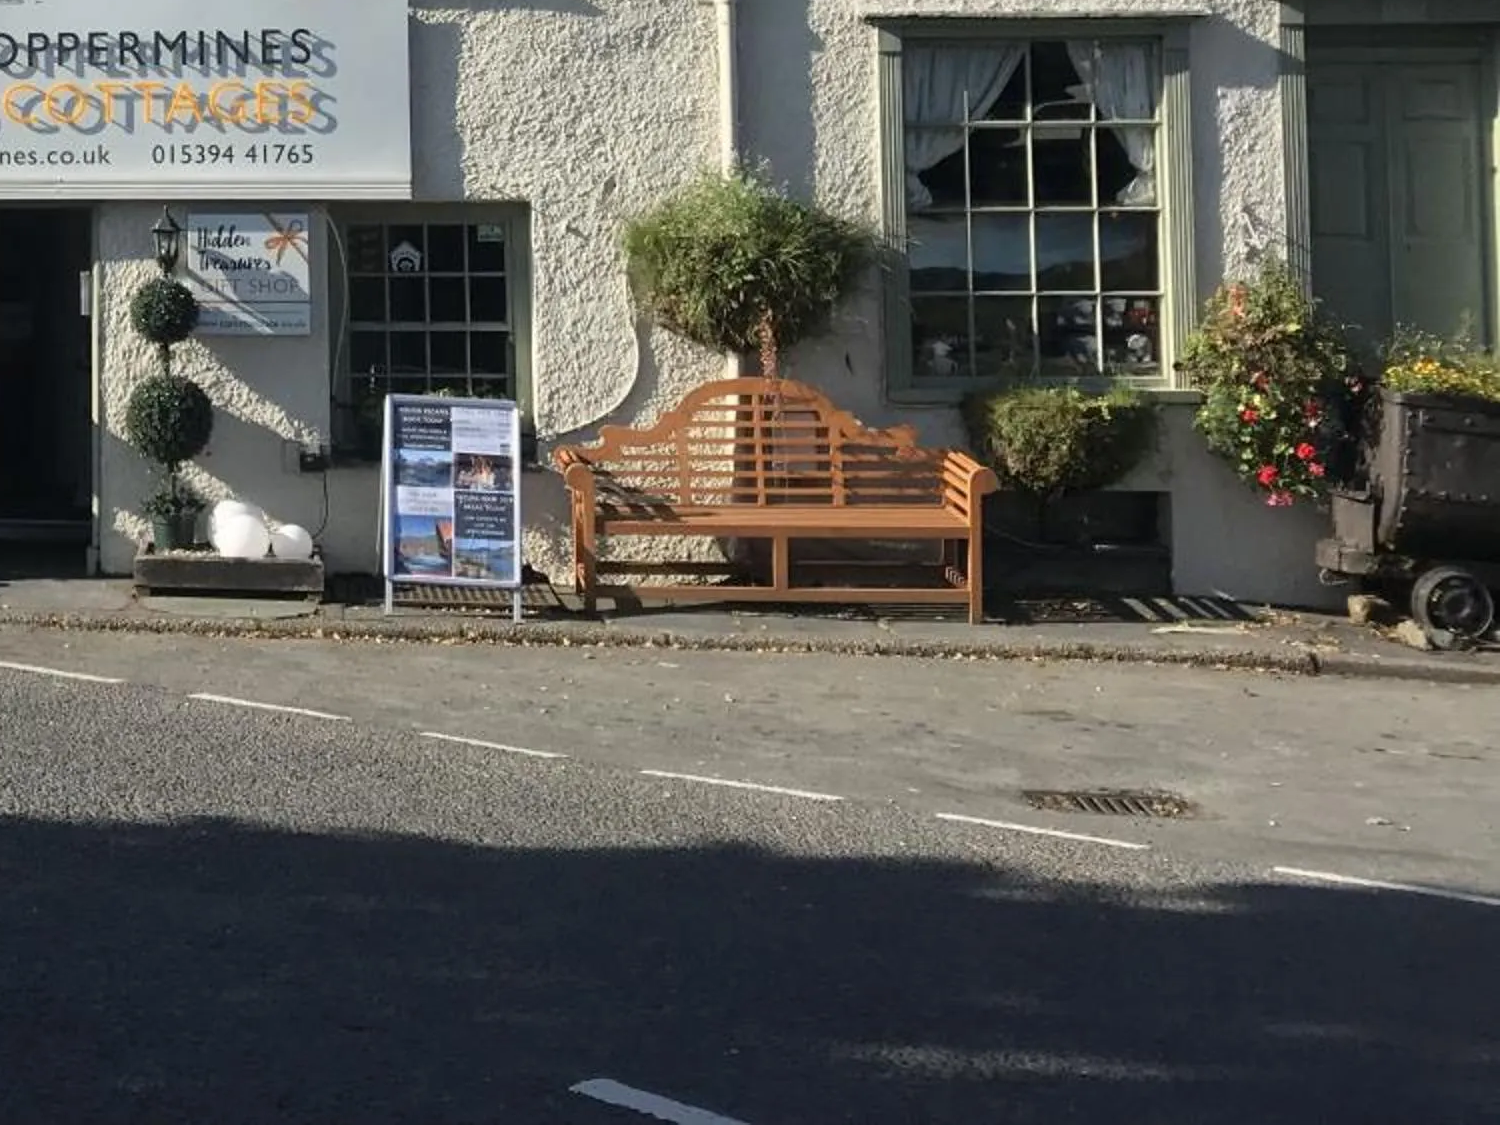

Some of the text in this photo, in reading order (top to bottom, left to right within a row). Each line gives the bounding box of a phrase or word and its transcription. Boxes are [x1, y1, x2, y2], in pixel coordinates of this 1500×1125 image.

[3, 76, 316, 124] COTTAGES
[152, 143, 235, 165] 015394
[245, 143, 314, 165] 41765
[196, 224, 251, 249] Hidden
[197, 250, 272, 271] Treasures
[248, 277, 300, 295] SHOP
